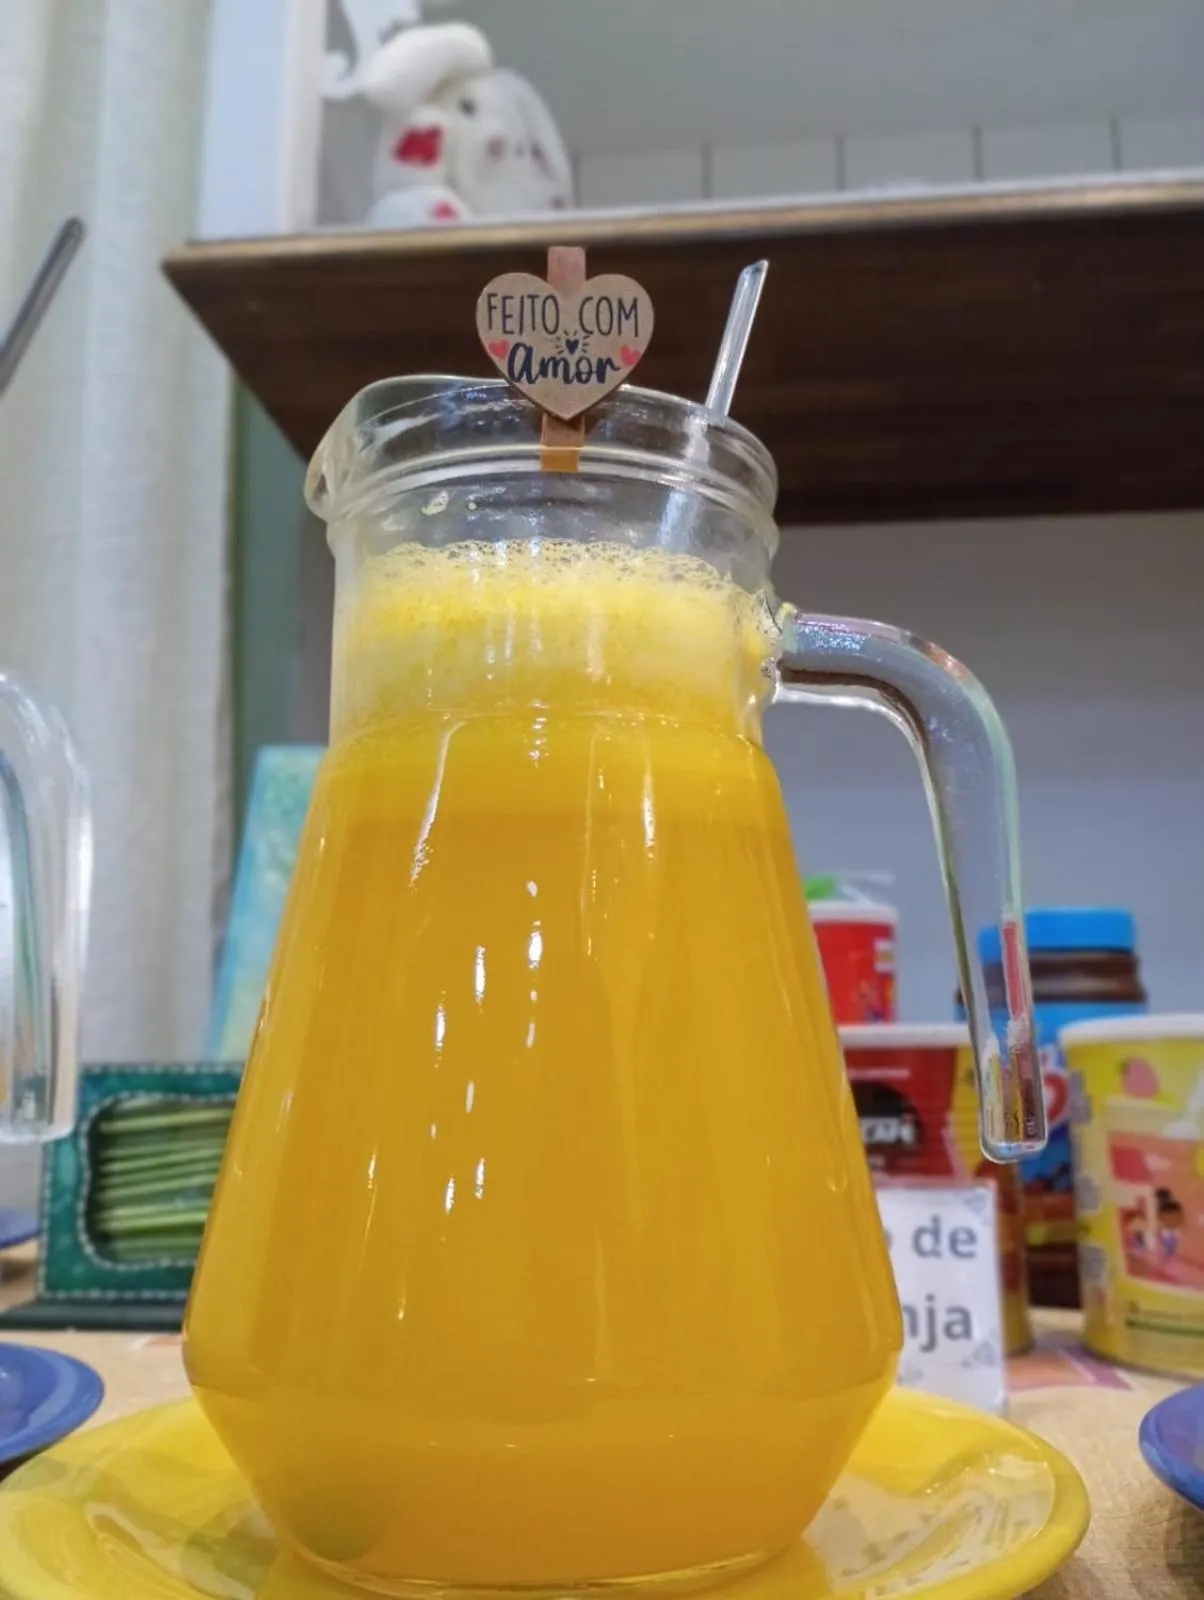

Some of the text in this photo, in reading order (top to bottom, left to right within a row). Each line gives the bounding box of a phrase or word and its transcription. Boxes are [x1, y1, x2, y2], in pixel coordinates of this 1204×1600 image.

[486, 293, 639, 338] FEITO COM
[912, 1214, 977, 1259] de
